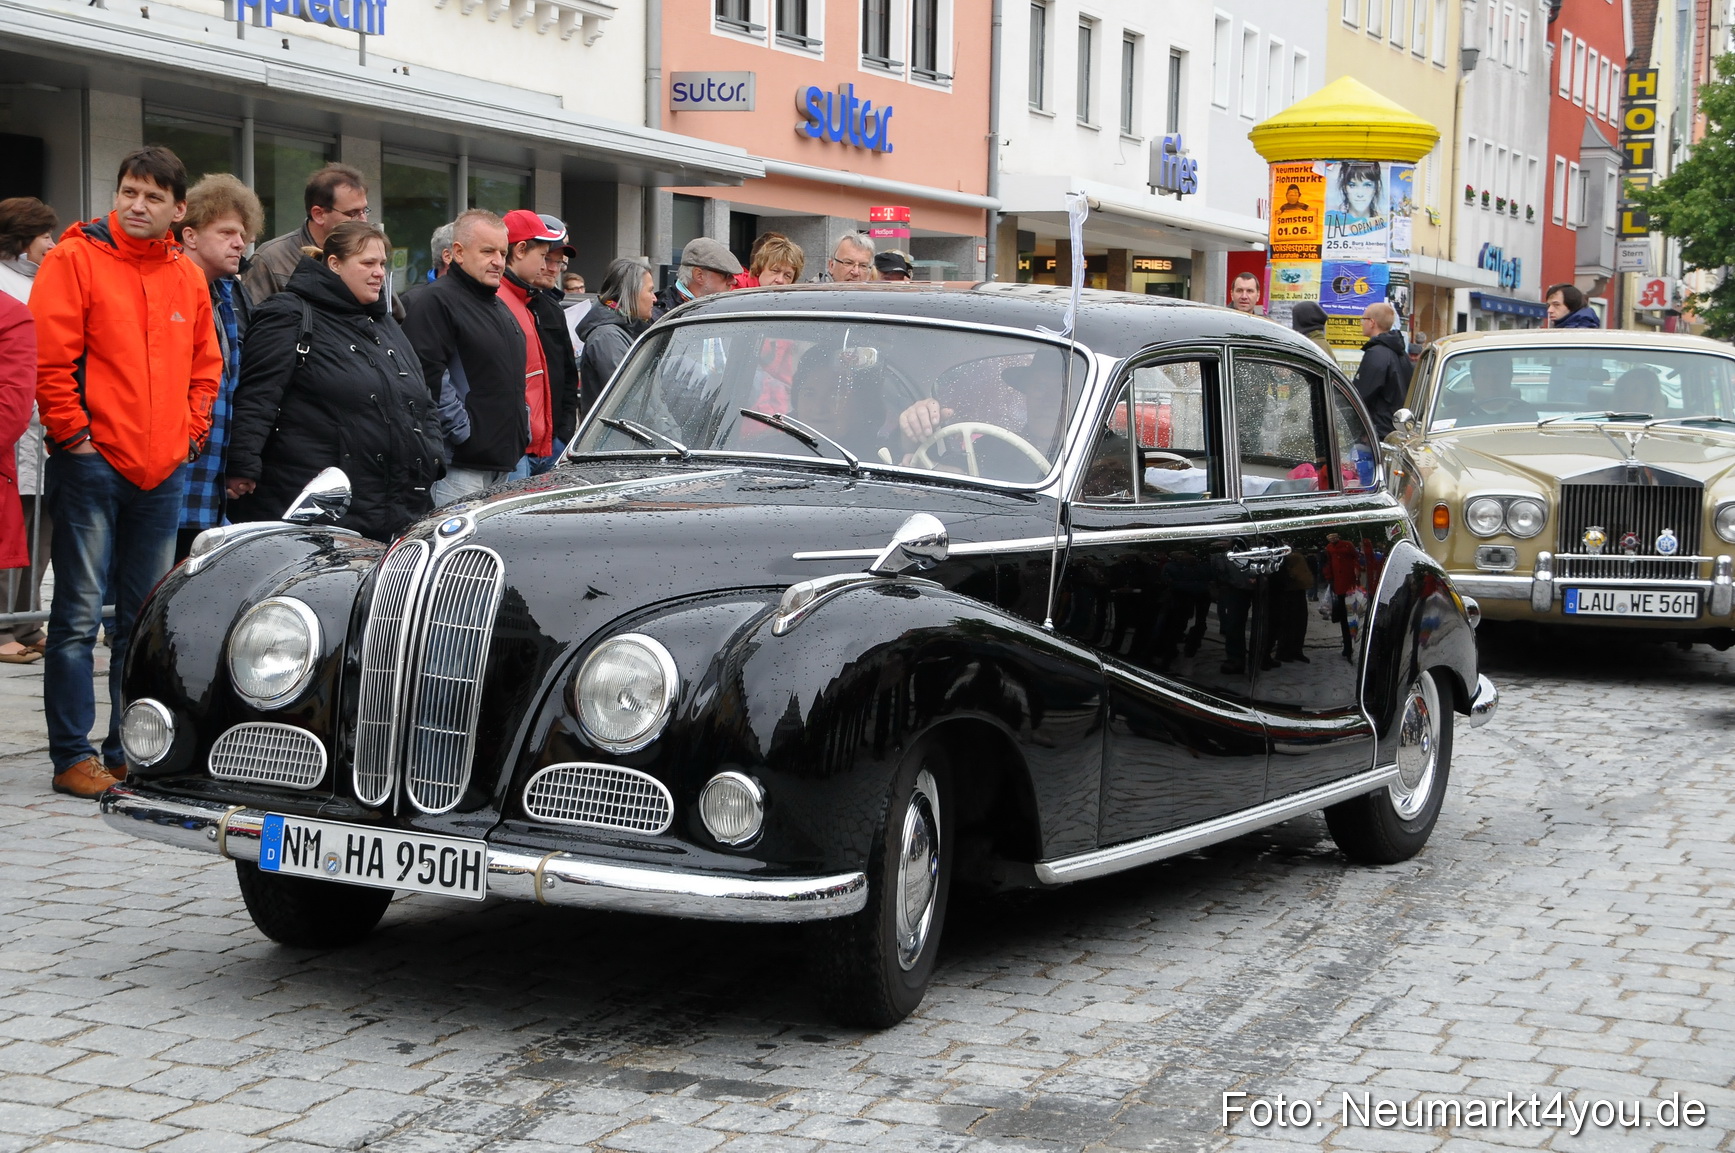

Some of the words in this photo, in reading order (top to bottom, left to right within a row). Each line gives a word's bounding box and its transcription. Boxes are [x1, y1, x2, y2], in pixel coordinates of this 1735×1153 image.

[1275, 175, 1323, 184] Flohmarkt
[1277, 215, 1314, 224] Samstag
[1277, 226, 1312, 236] 01.06.
[1326, 213, 1348, 239] ZAZ
[1350, 221, 1373, 236] OPEN
[1374, 217, 1386, 230] AIR
[1272, 244, 1318, 252] Volksfestplatz
[1326, 240, 1352, 249] 25.6.
[1134, 259, 1173, 270] FRIES
[1578, 592, 1615, 612] LAU
[1630, 593, 1653, 613] WE
[1659, 594, 1696, 615] 56H
[267, 848, 275, 861] D
[282, 824, 323, 869] NM
[345, 833, 385, 879] HA
[396, 840, 481, 892] 950H
